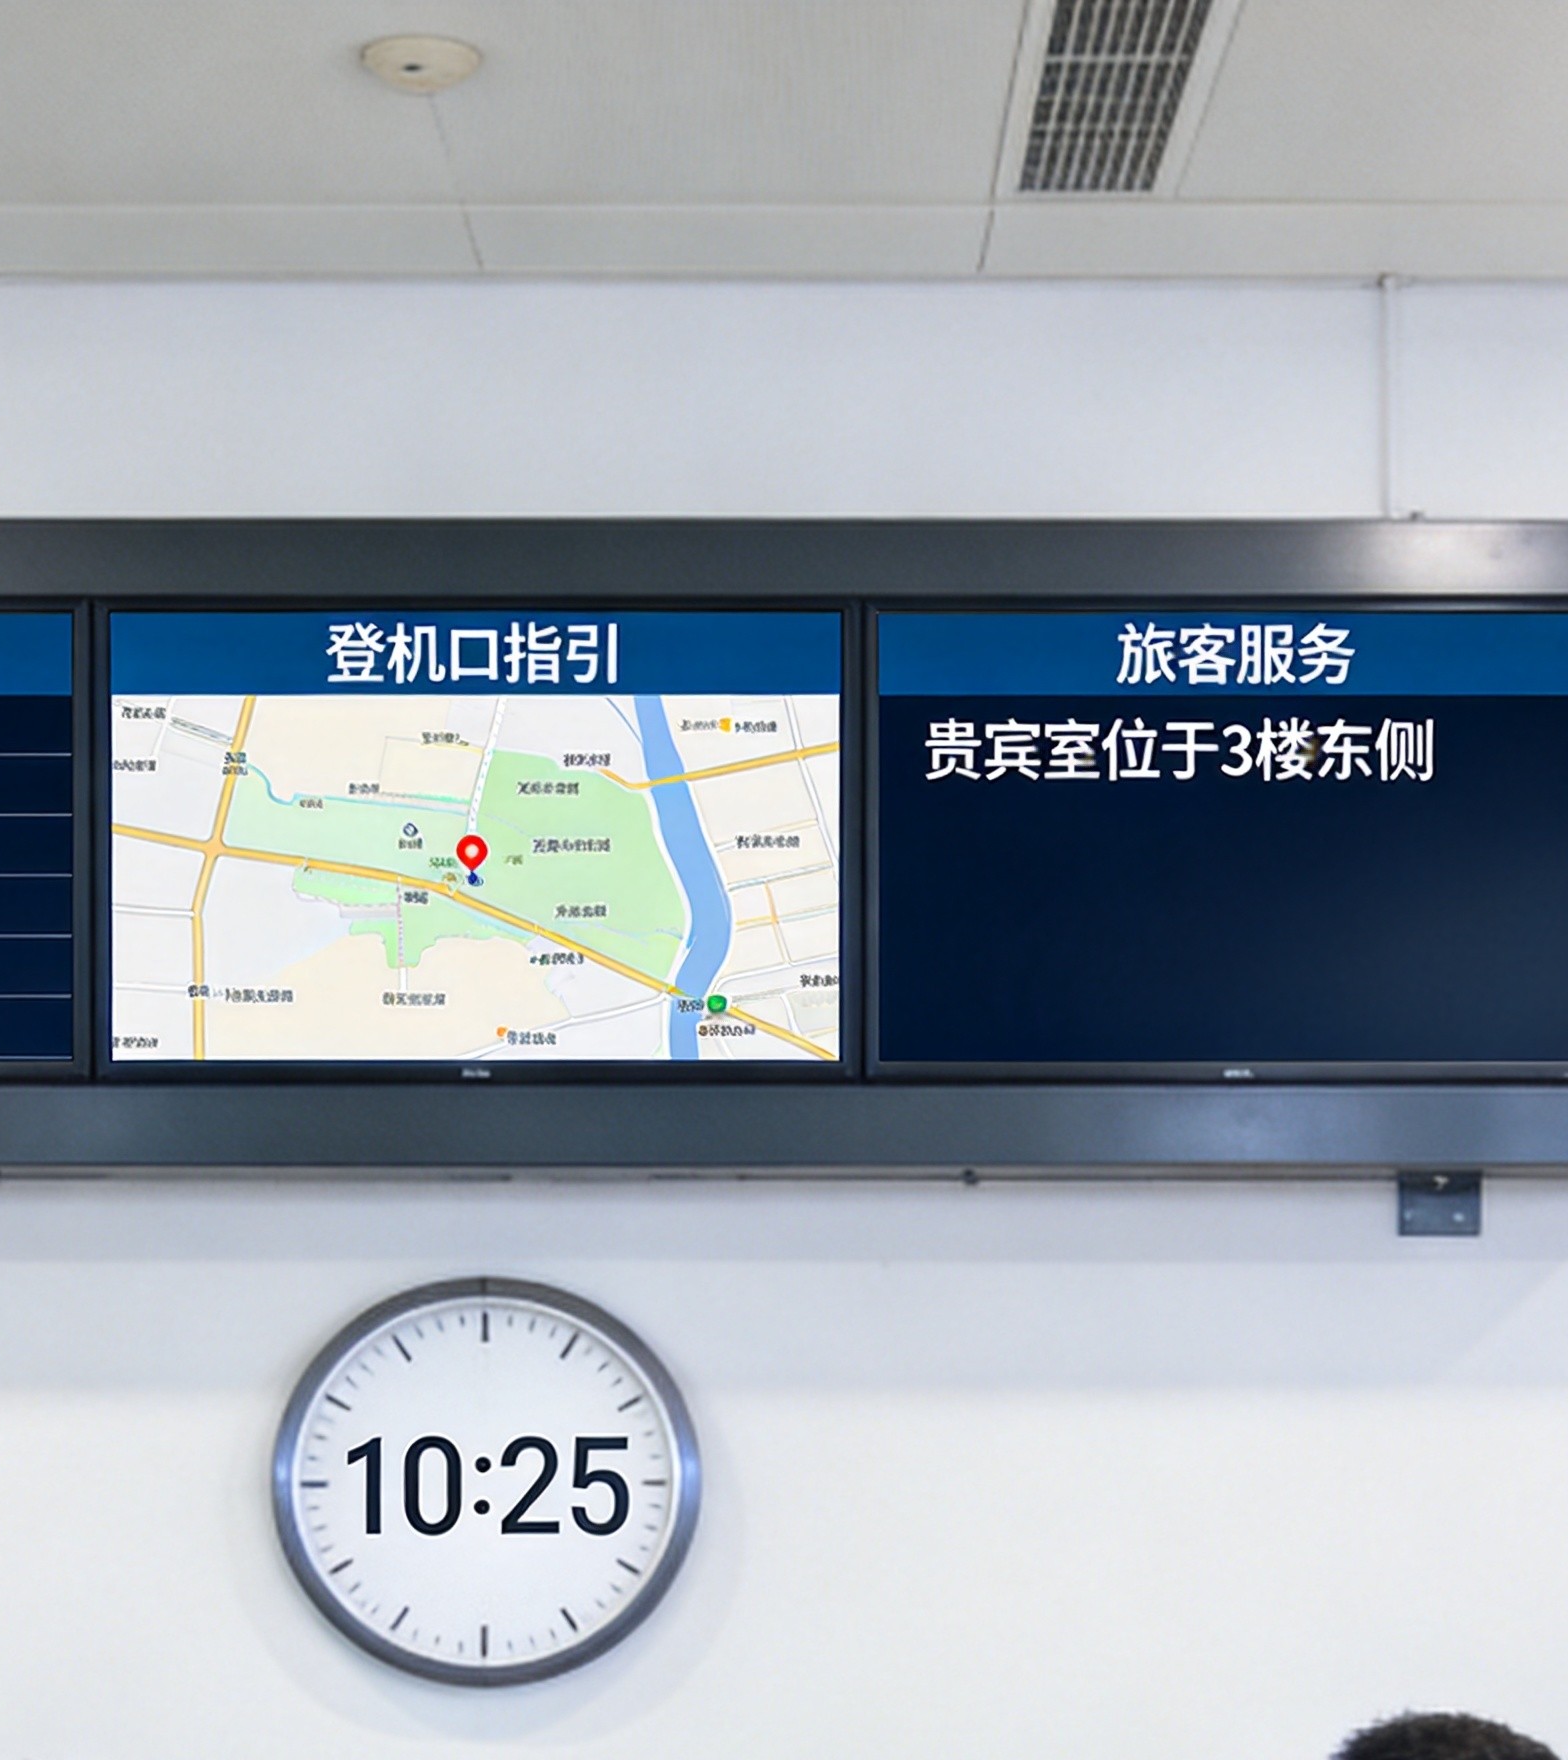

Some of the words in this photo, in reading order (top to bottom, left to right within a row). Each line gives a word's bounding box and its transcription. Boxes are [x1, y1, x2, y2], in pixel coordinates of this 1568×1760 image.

[325, 621, 618, 685] 登机口指引
[1116, 621, 1356, 685] 旅客服务
[924, 716, 1434, 782] 贵宾室位于3楼东侧
[347, 1435, 630, 1536] 10:25
